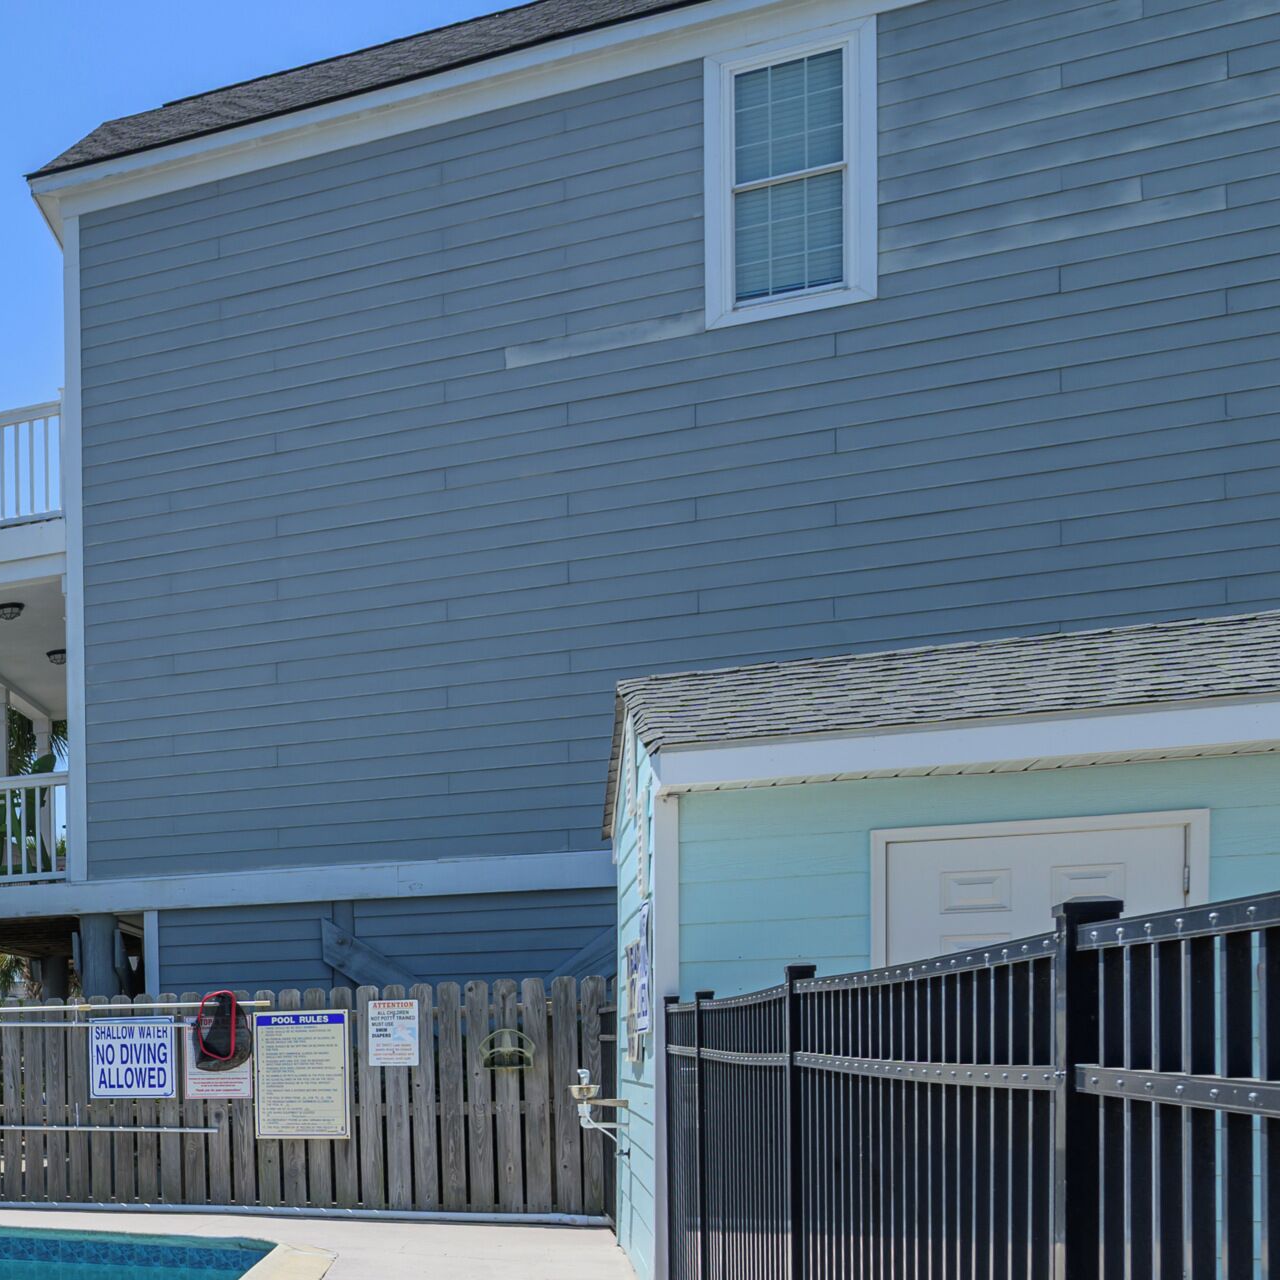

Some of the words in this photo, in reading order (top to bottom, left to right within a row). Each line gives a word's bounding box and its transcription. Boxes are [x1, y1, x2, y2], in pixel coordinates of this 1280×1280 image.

[271, 1016, 295, 1024] POOL
[299, 1015, 329, 1023] RULES
[95, 1025, 135, 1040] SHALLOW
[138, 1025, 168, 1039] WATER
[96, 1043, 115, 1065] NO
[120, 1042, 168, 1064] DIVING
[98, 1067, 167, 1089] ALLOWED
